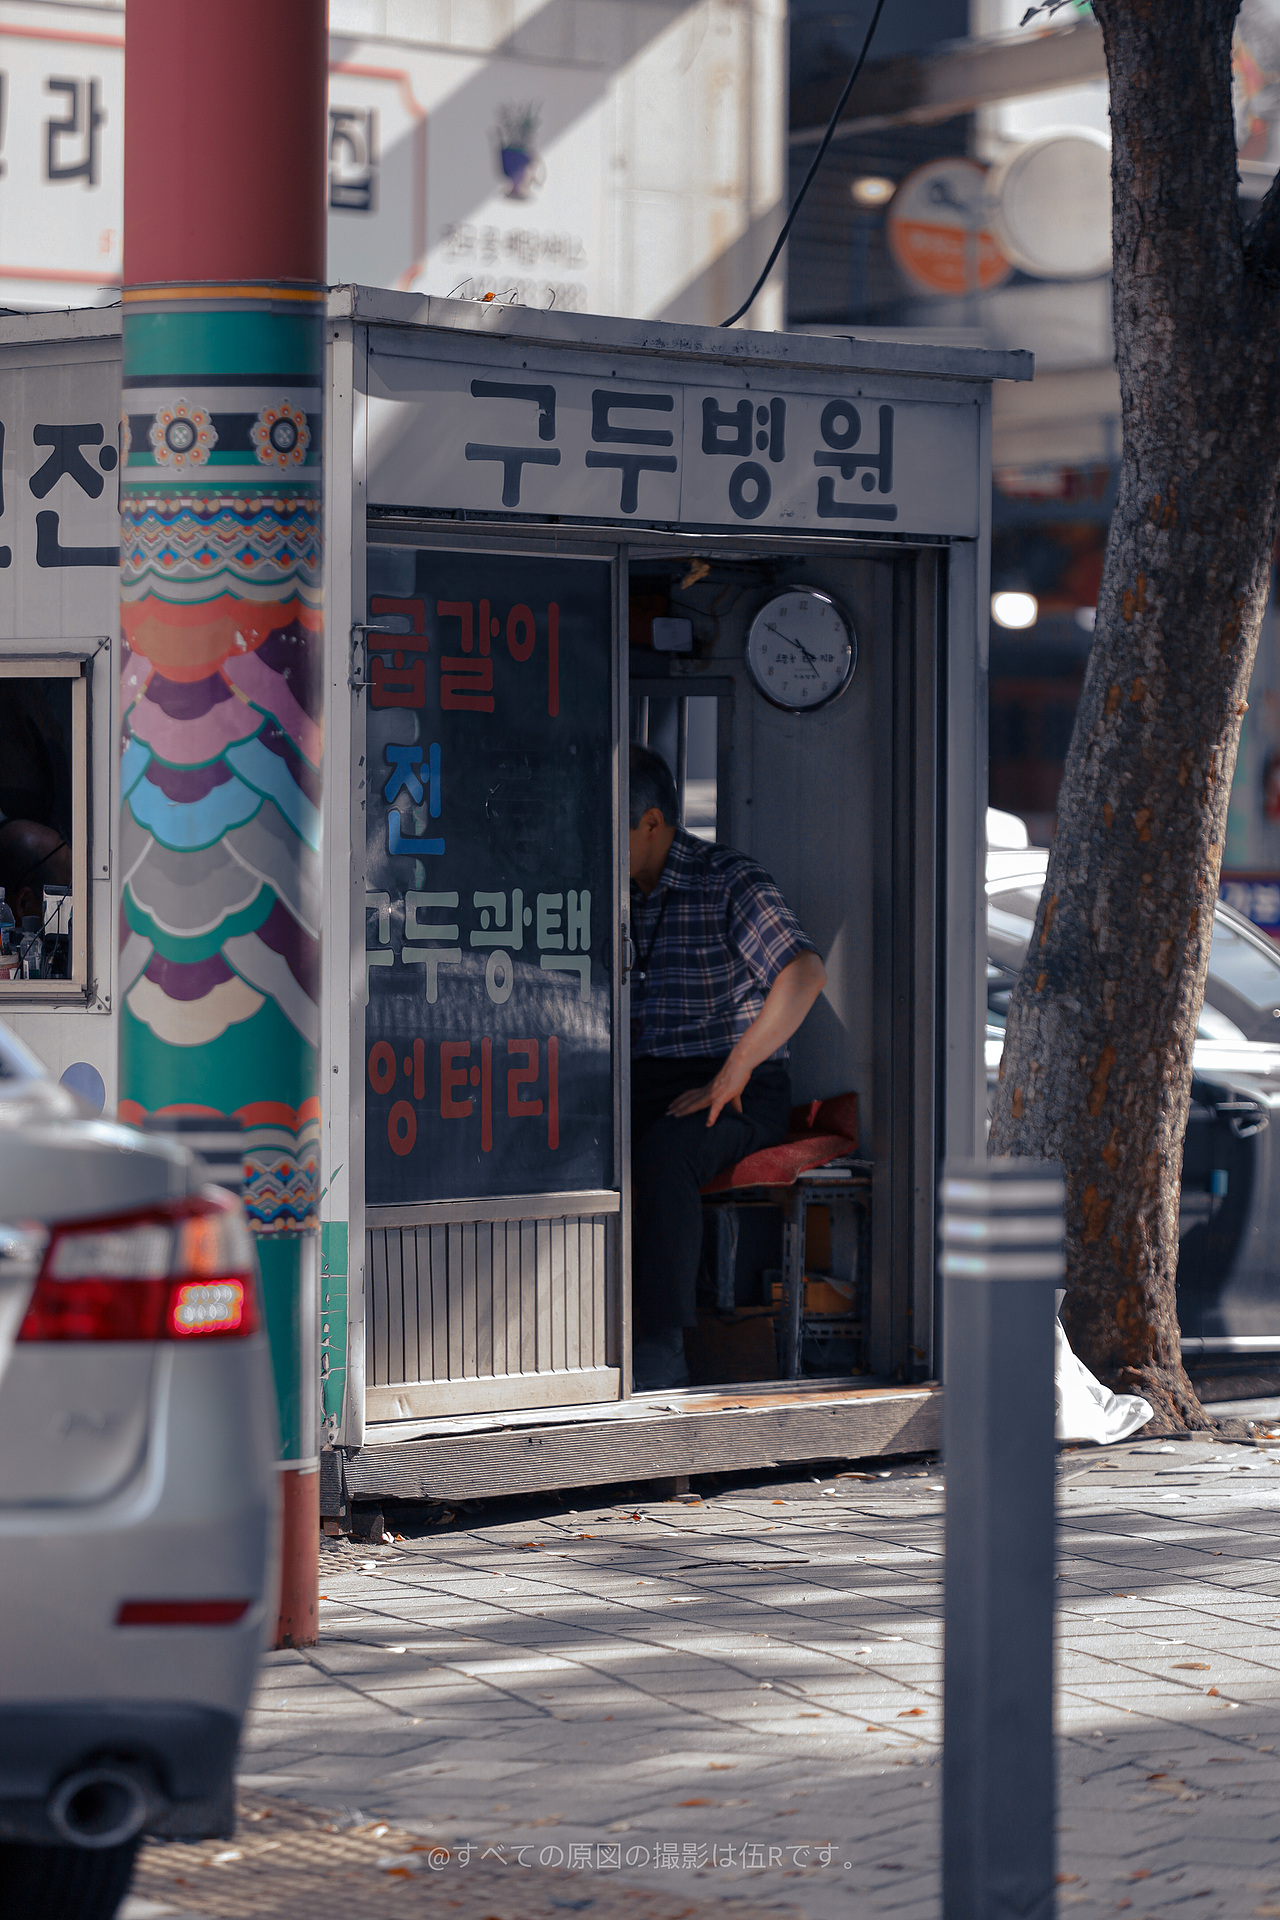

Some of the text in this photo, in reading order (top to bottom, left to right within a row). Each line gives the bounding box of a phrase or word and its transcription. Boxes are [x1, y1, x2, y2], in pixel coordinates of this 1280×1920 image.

[464, 378, 899, 522] 구두병원
[368, 598, 560, 718] 굽갈이
[384, 742, 445, 855] 전
[368, 1035, 559, 1156] 엉터리
